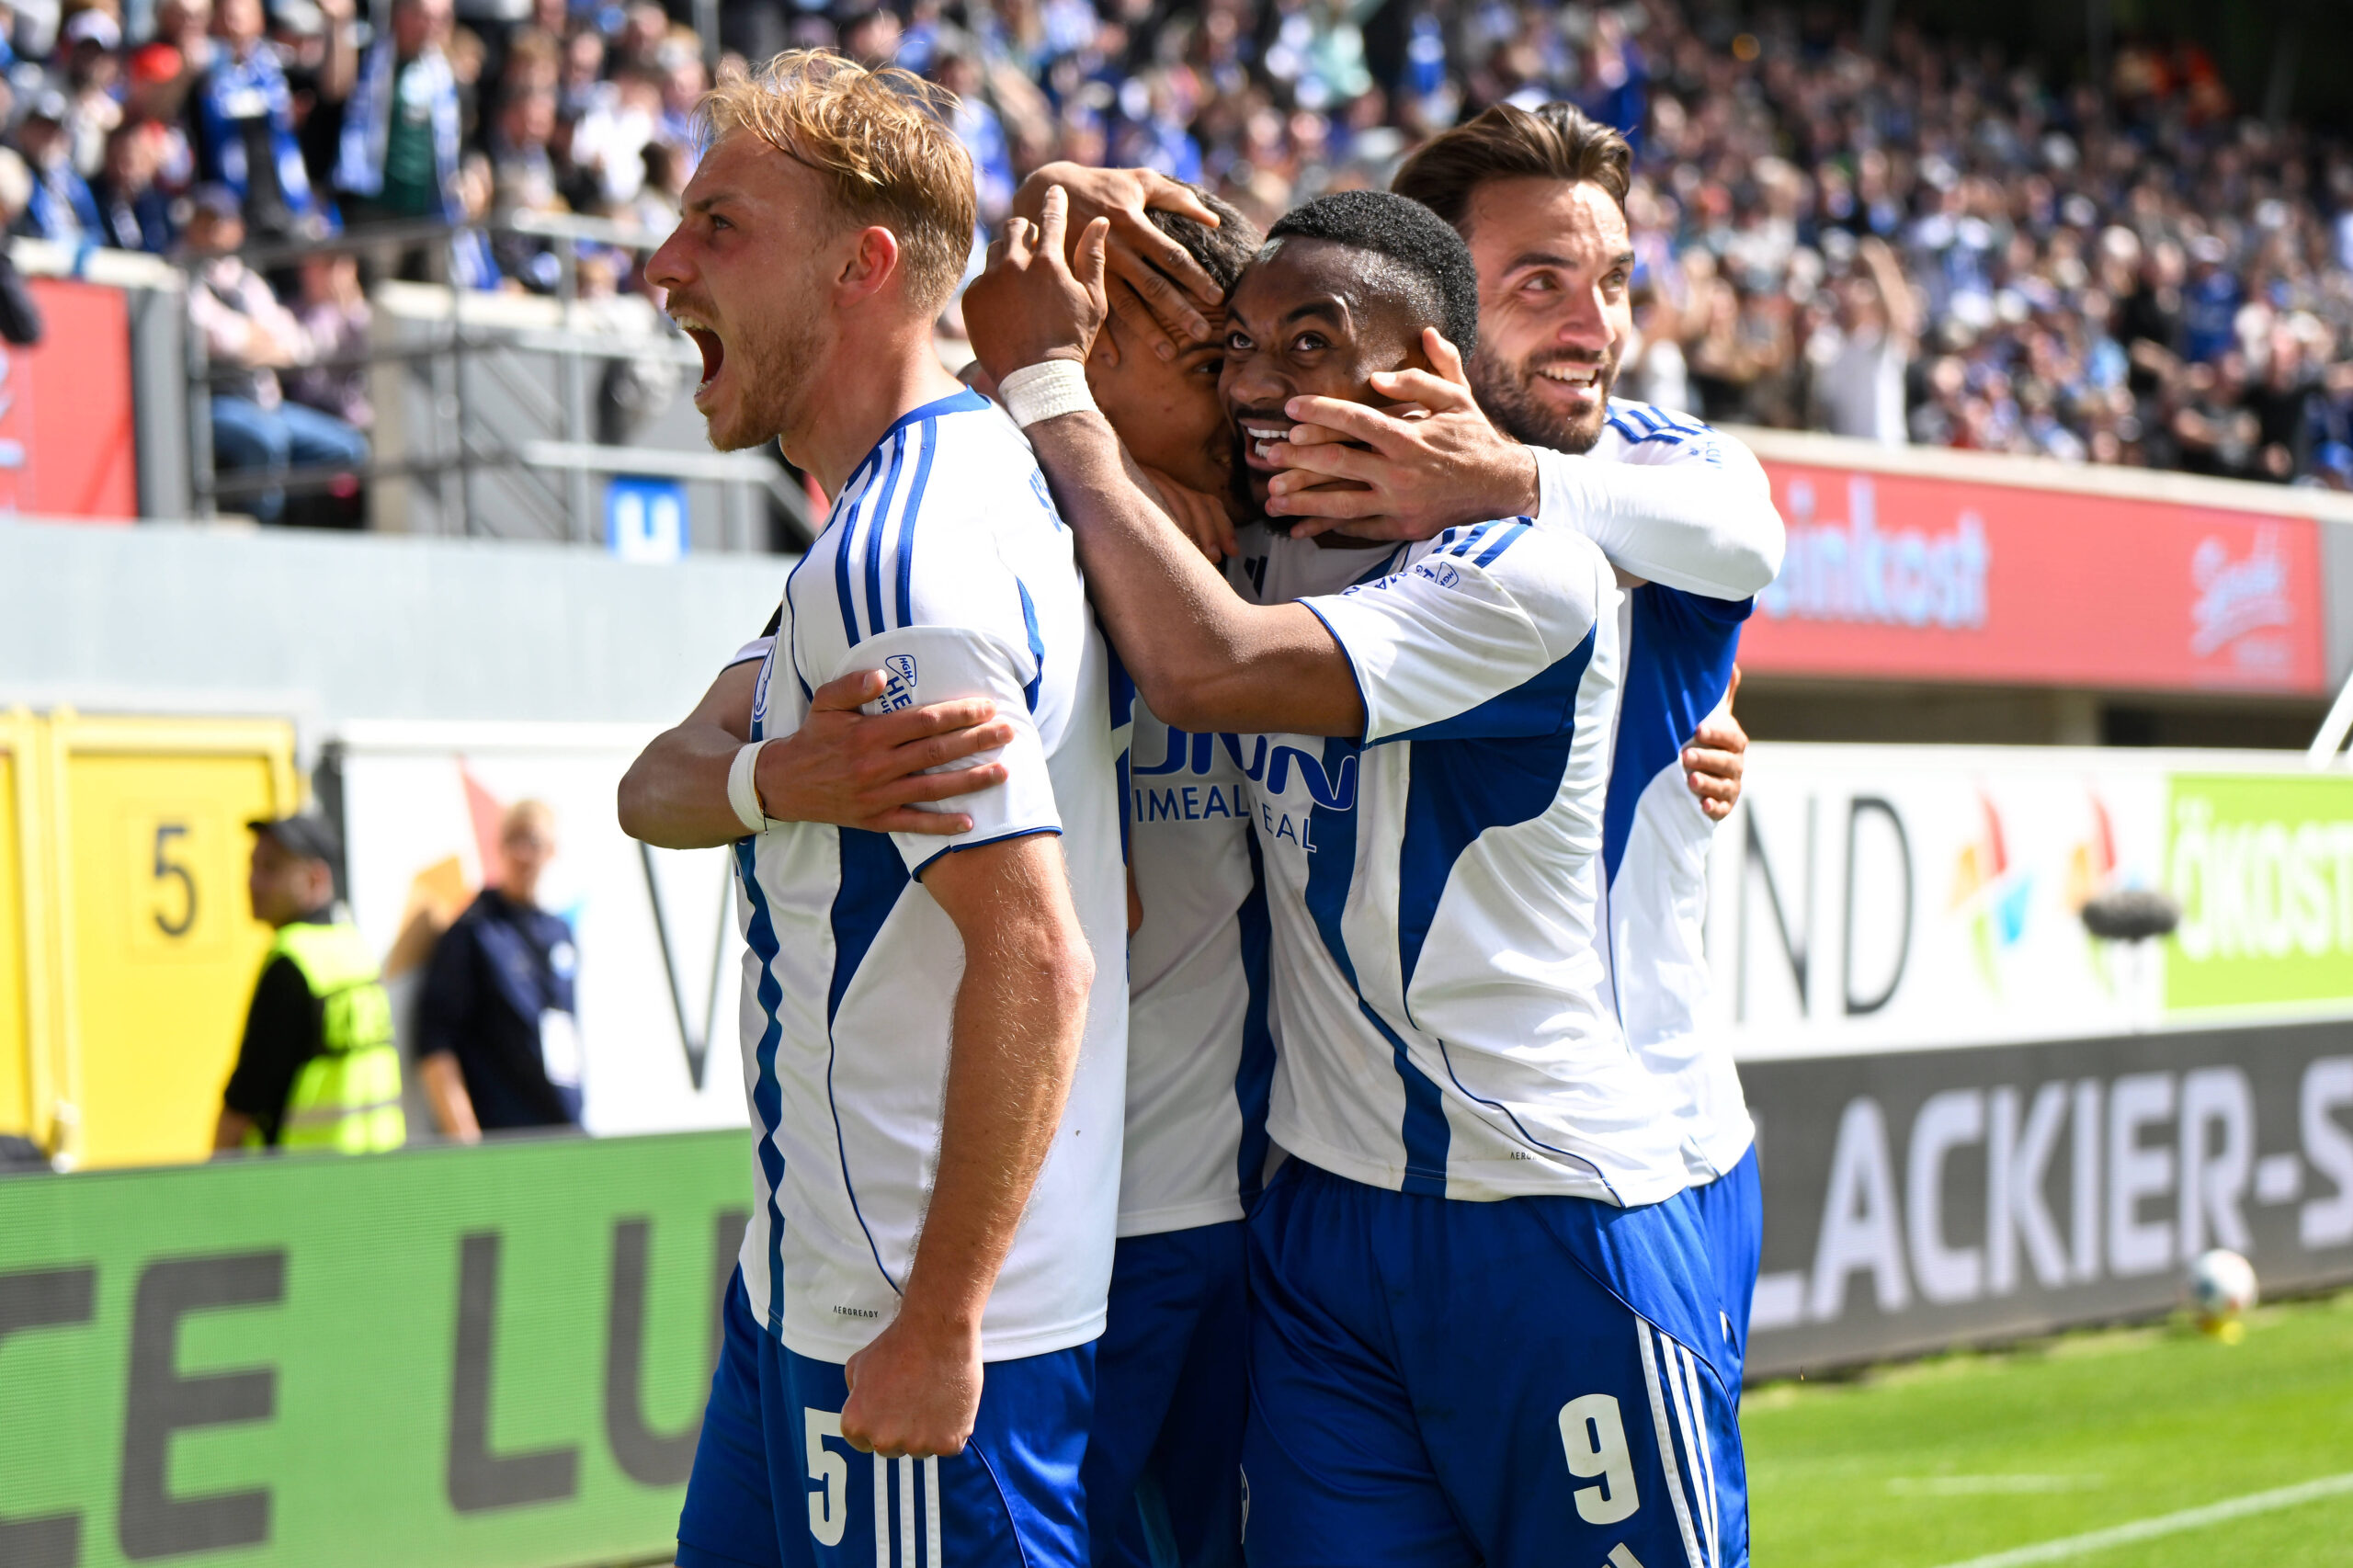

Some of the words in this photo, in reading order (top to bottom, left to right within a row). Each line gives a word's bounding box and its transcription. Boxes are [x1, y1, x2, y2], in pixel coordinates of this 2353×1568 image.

[1760, 472, 1993, 631] inkost
[898, 657, 915, 679] HGH
[153, 824, 198, 938] 5
[833, 1304, 879, 1319] AEROREADY
[804, 1406, 847, 1548] 5
[1558, 1393, 1640, 1525] 9
